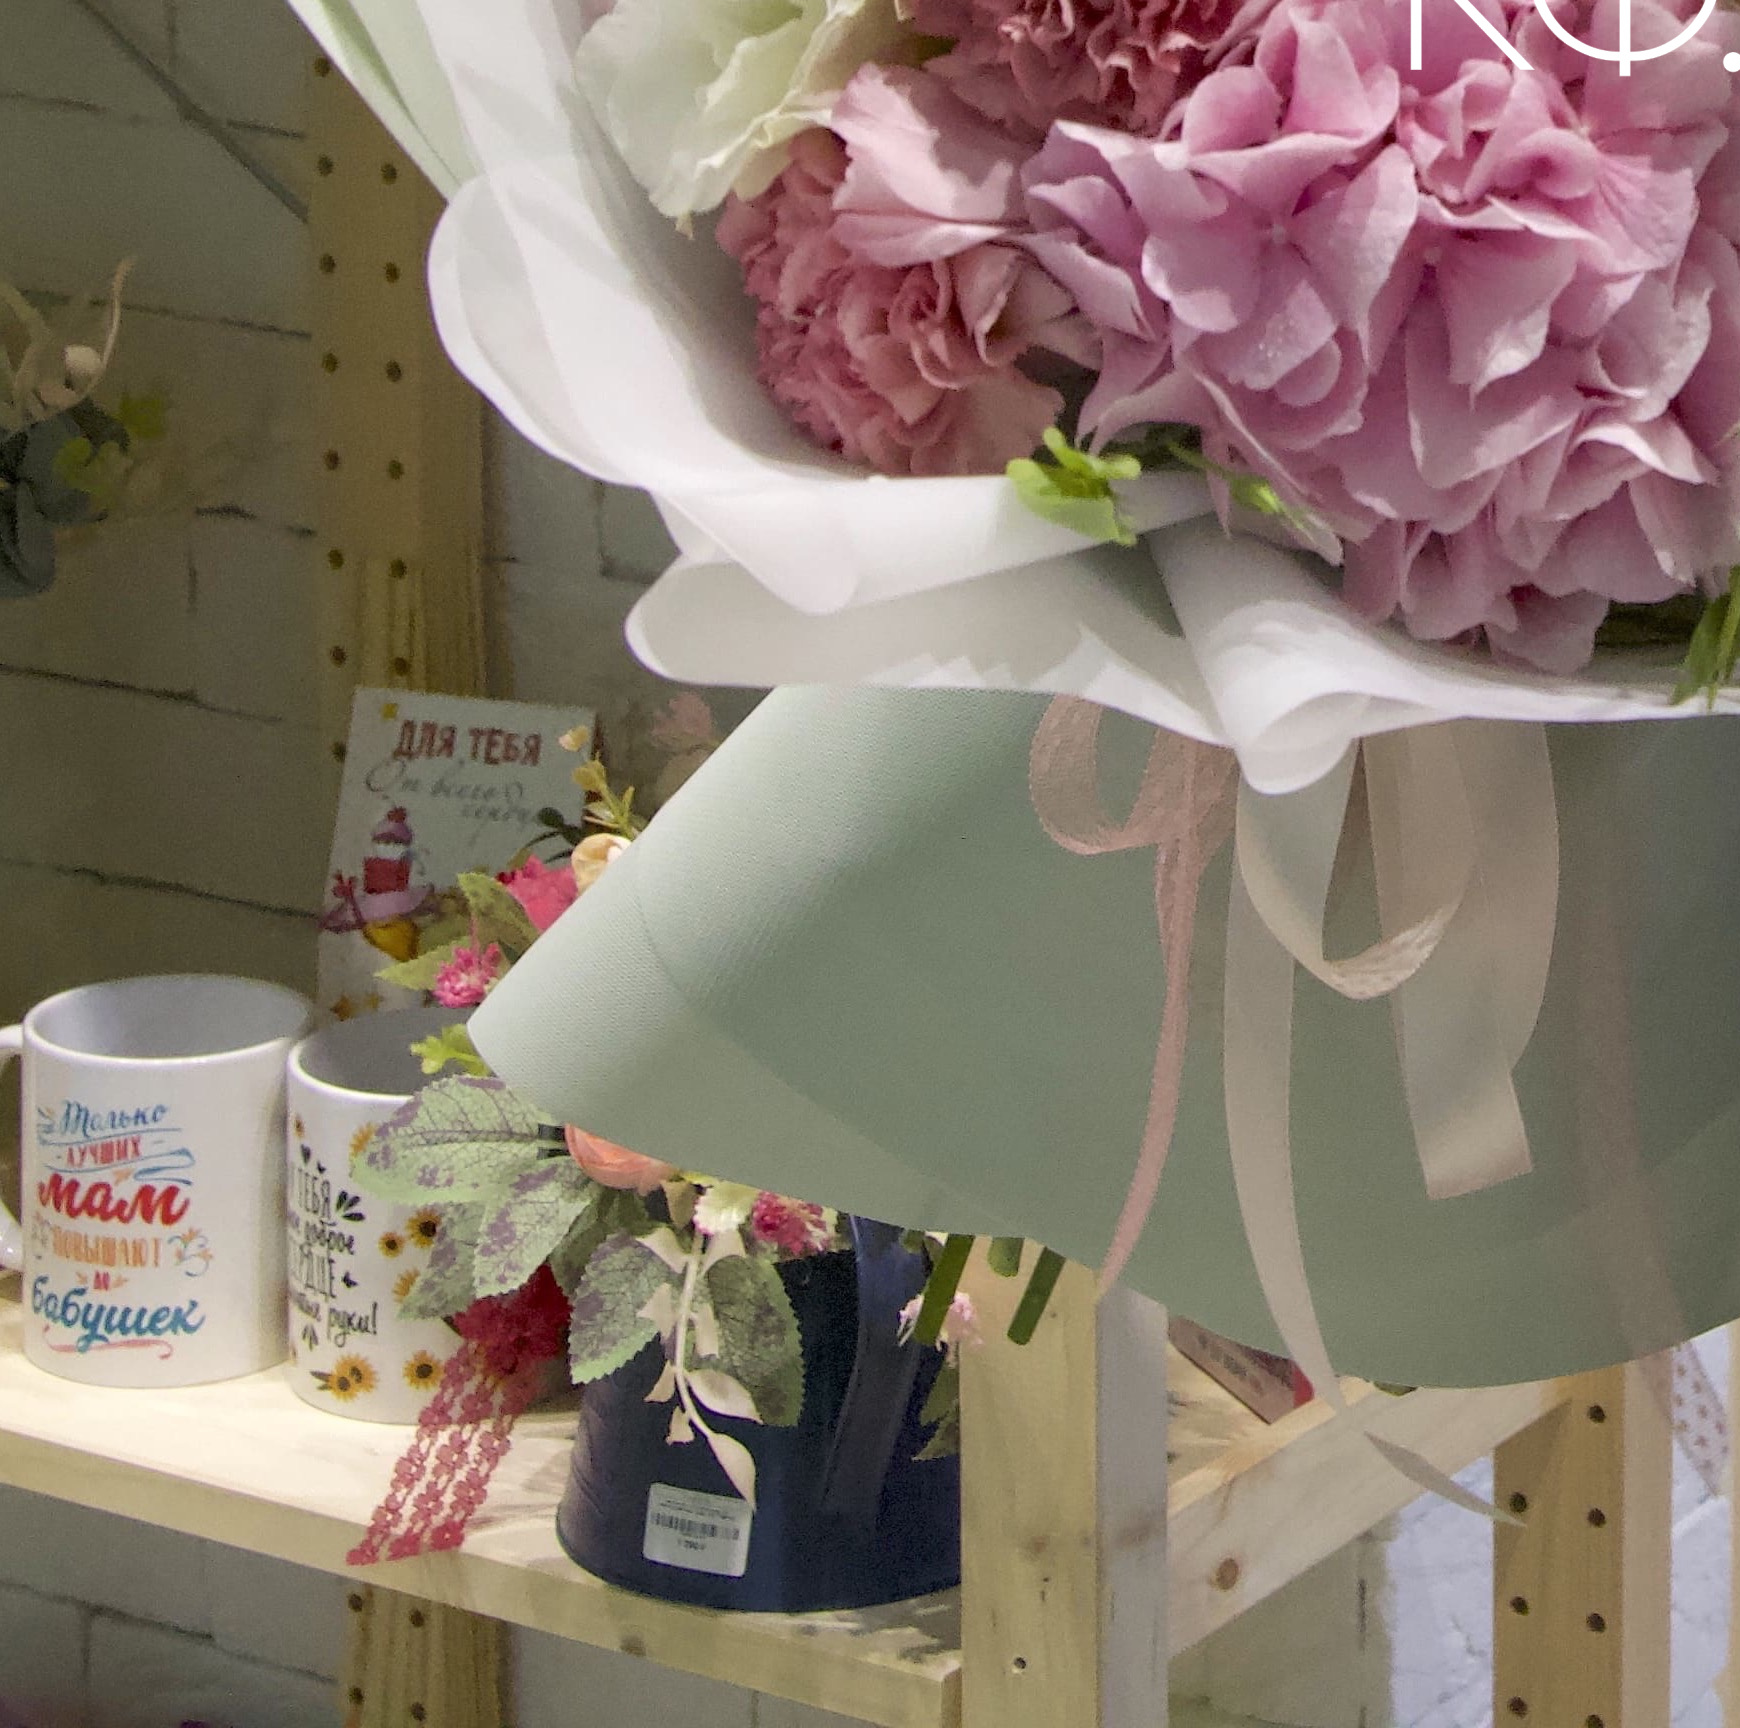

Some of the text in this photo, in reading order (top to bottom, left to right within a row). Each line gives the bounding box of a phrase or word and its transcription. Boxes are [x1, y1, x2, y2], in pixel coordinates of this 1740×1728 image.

[393, 720, 543, 766] ДЛЯ ТЕБЯ
[61, 1100, 168, 1138] Только
